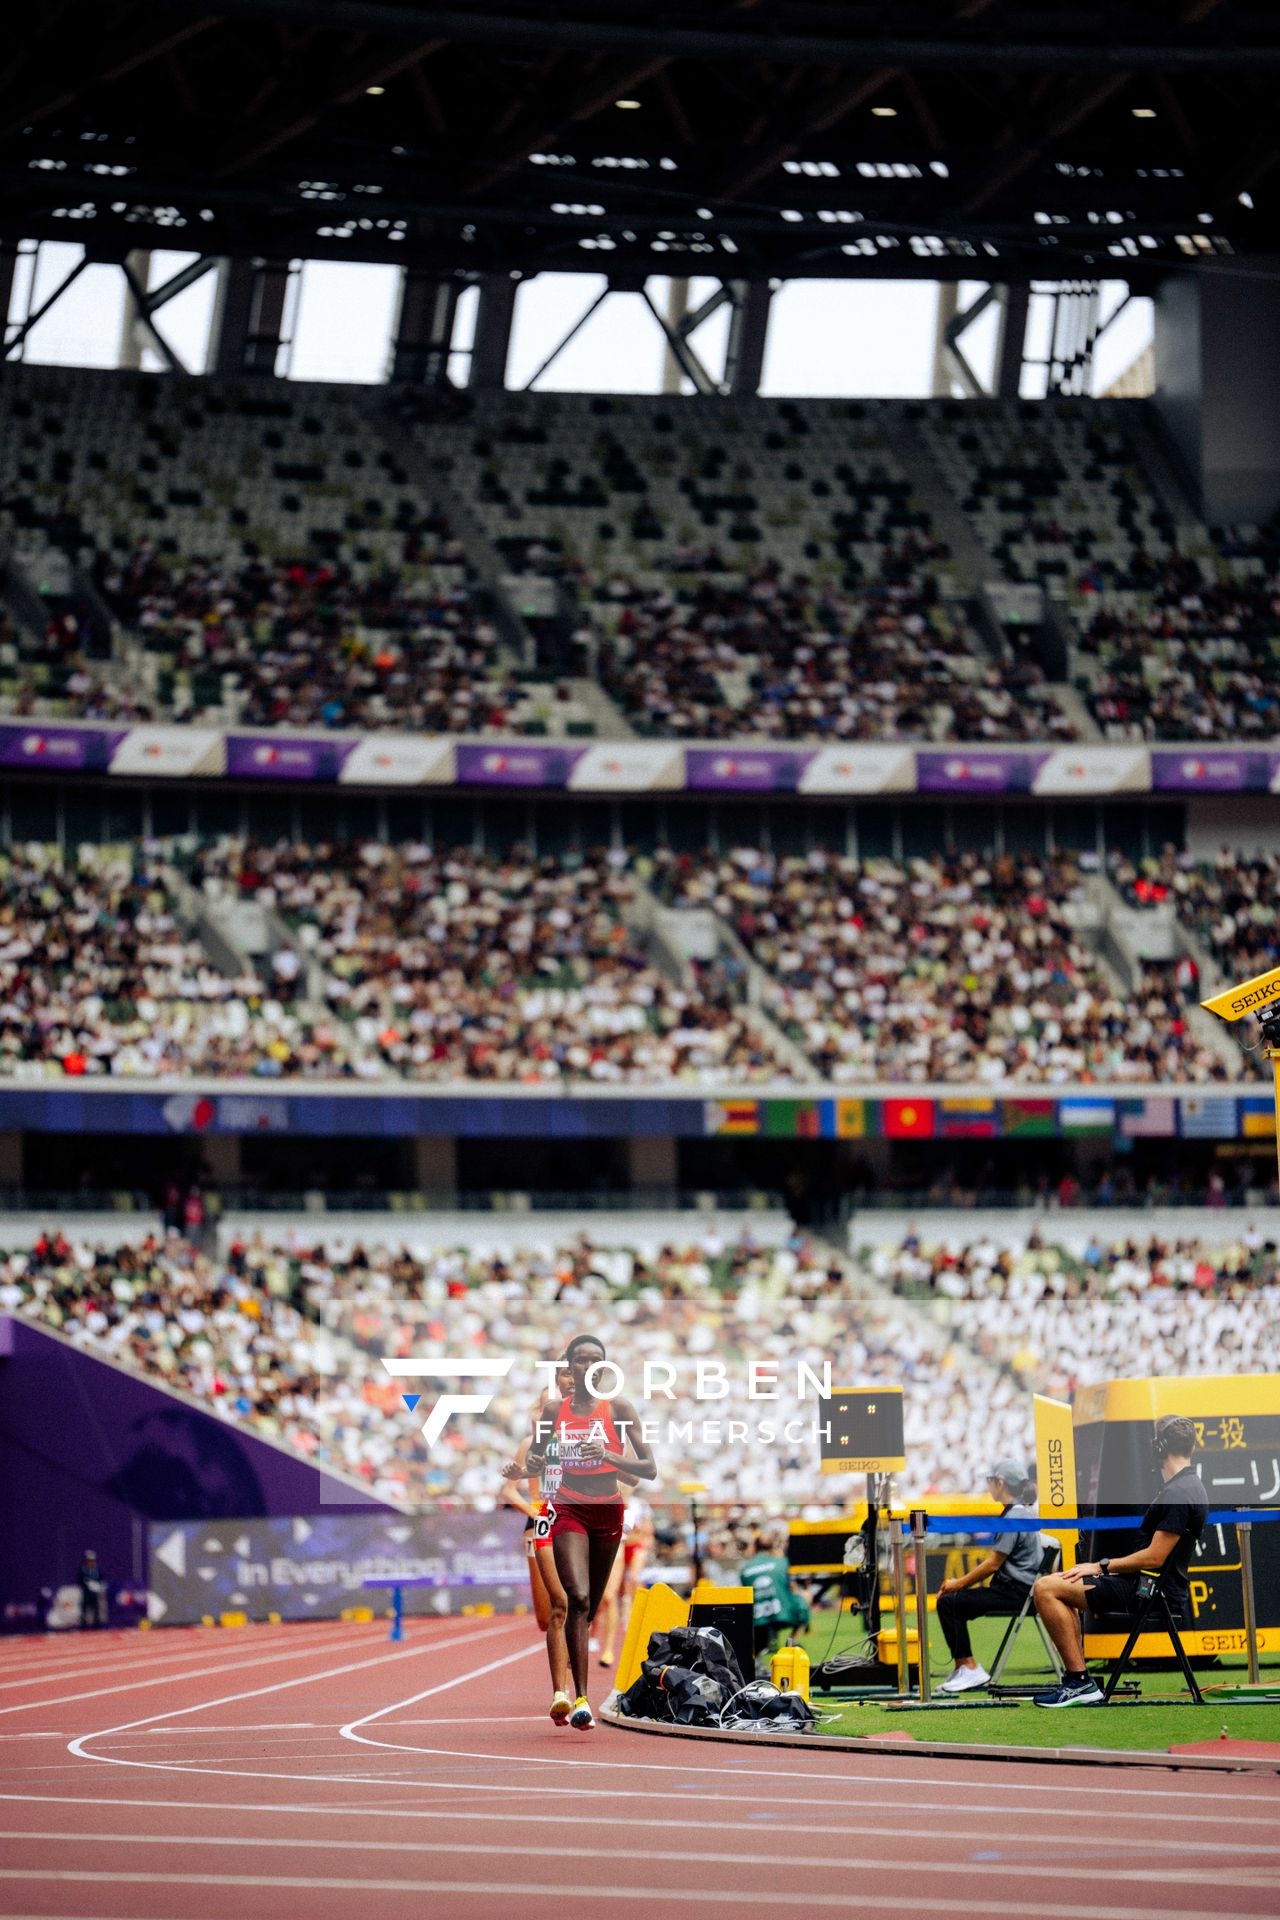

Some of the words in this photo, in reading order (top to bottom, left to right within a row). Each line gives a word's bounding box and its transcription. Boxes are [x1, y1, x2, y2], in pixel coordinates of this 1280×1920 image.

[1231, 980, 1280, 1013] SEIKO
[838, 1460, 881, 1472] SEIKO
[1048, 1439, 1065, 1507] SEIKO
